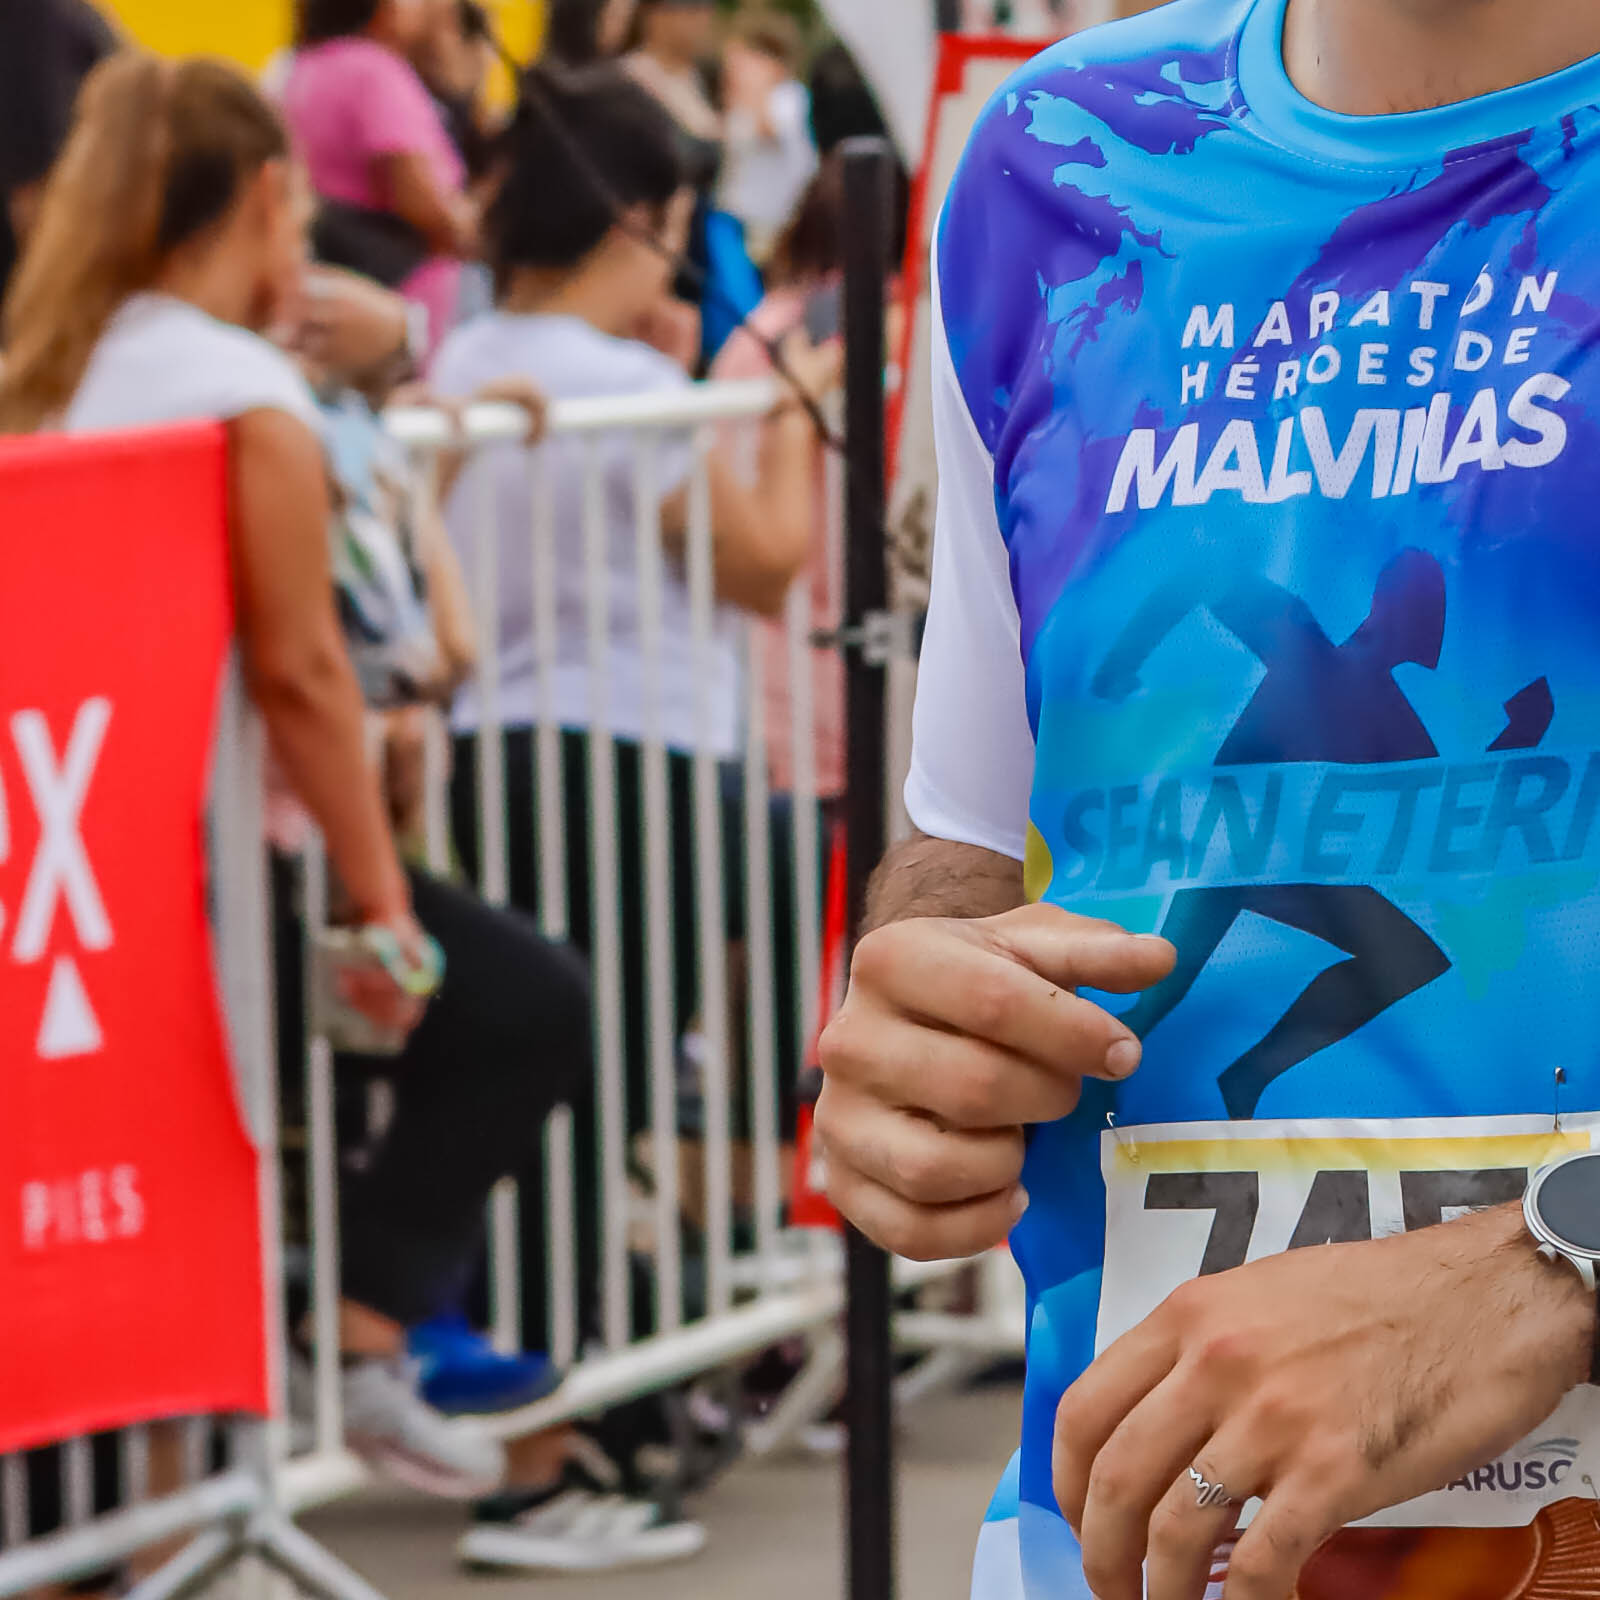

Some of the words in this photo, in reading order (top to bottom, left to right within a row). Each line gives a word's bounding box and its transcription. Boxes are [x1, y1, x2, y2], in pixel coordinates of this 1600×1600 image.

[1181, 263, 1559, 349] MARATÓN
[1180, 343, 1438, 405] HÉROES
[1453, 326, 1538, 373] DE
[1060, 770, 1282, 898] SEAN
[22, 1163, 145, 1252] PIES
